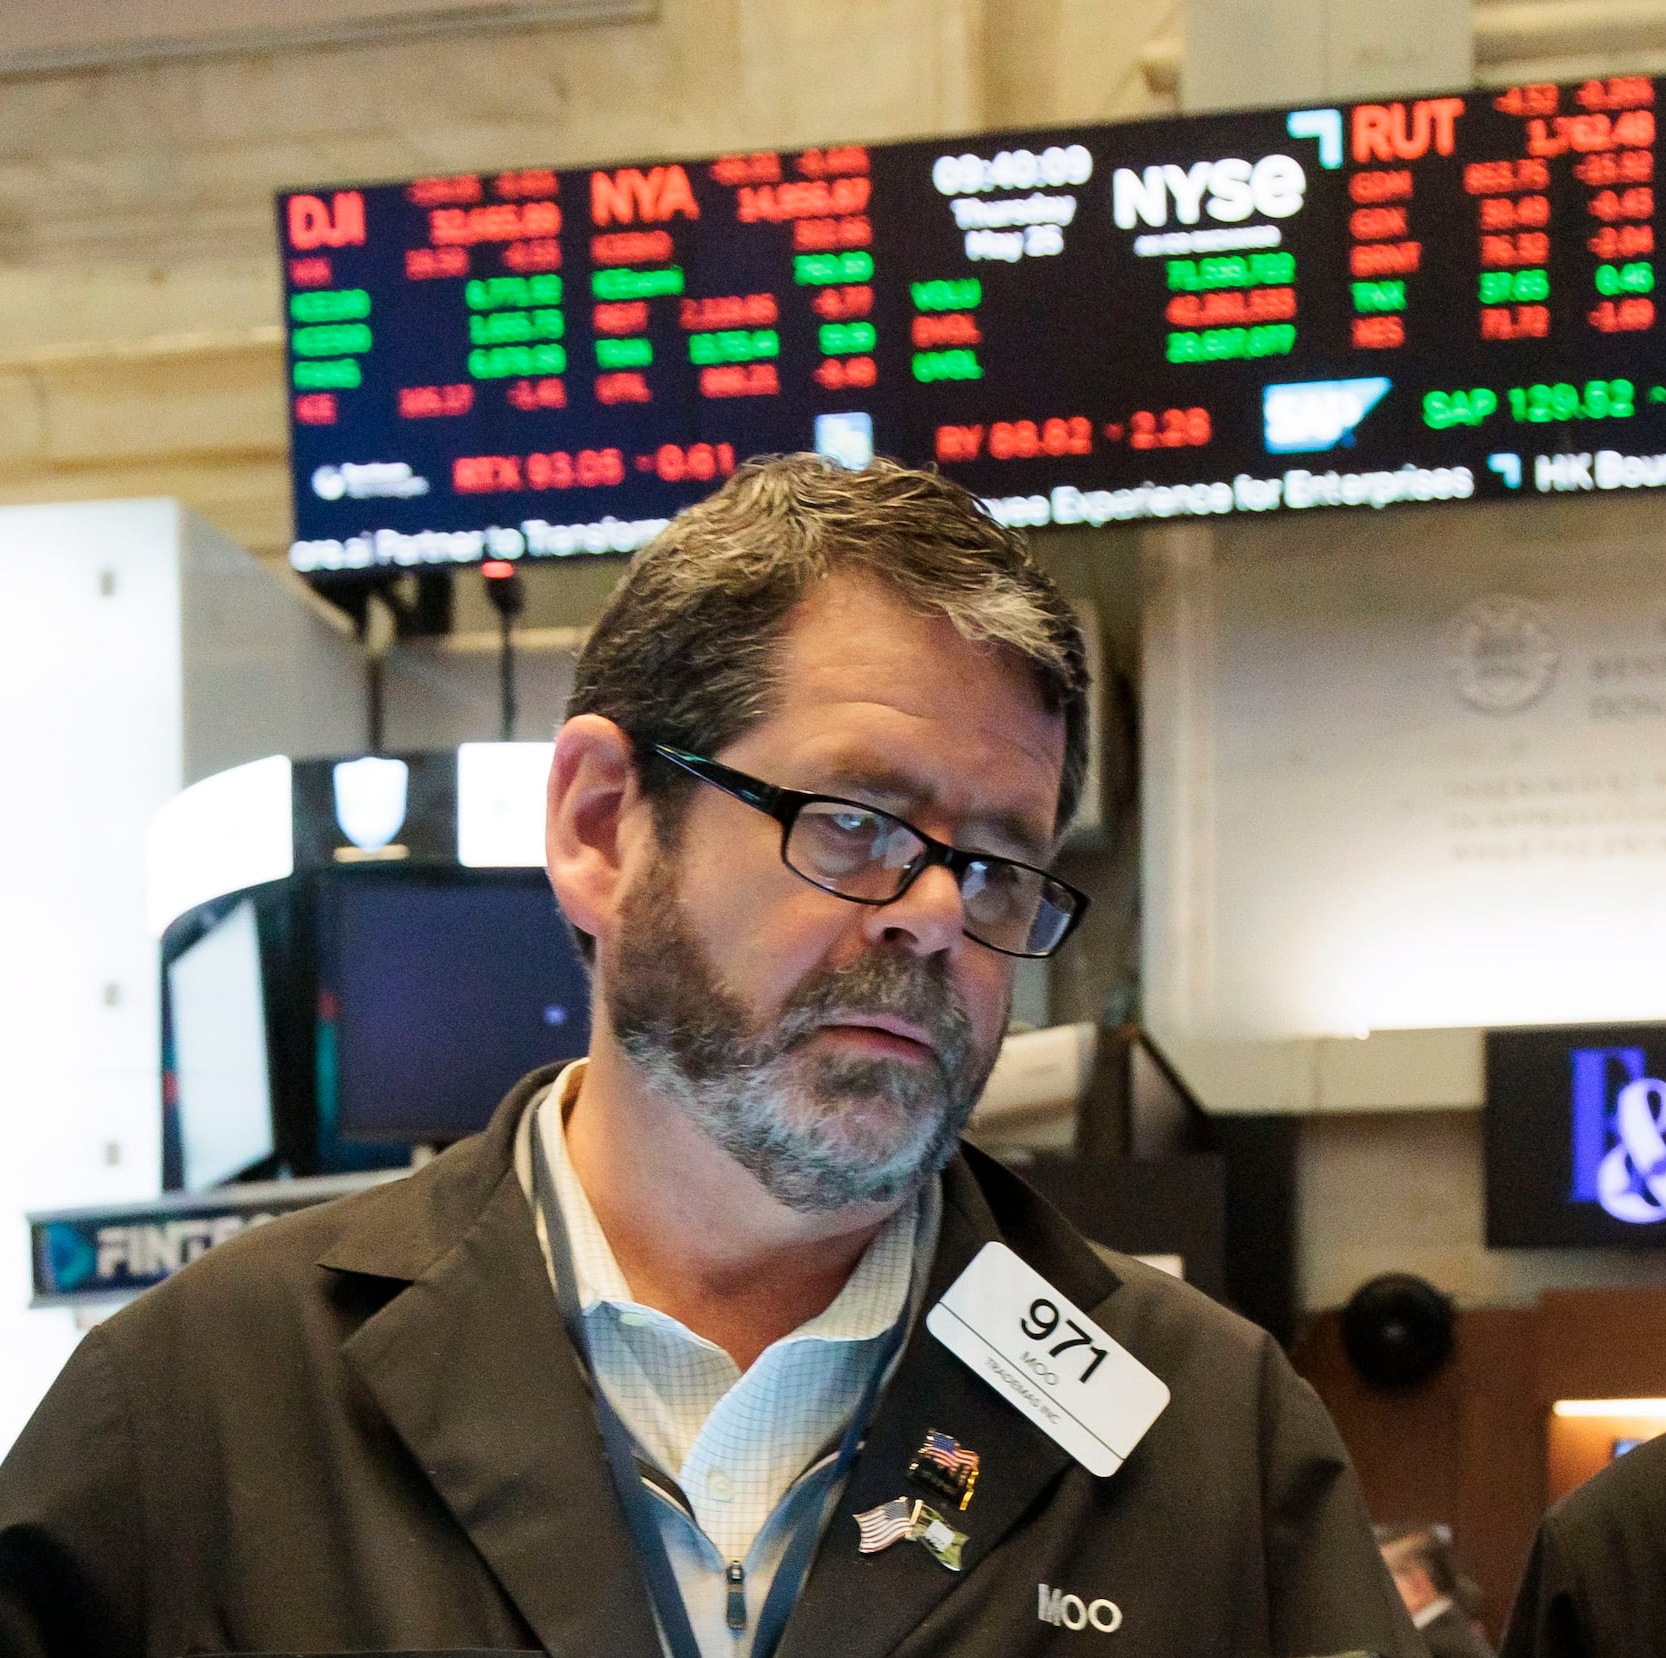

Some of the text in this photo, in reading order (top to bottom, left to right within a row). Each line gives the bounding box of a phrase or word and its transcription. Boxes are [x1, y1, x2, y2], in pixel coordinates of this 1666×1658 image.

[1352, 98, 1464, 162] RUT
[289, 192, 365, 250] DJI
[592, 165, 699, 226] NYA
[1423, 389, 1495, 428] SAP
[1535, 452, 1594, 492] HK
[1021, 1298, 1109, 1383] 971
[1021, 1351, 1060, 1385] MOO
